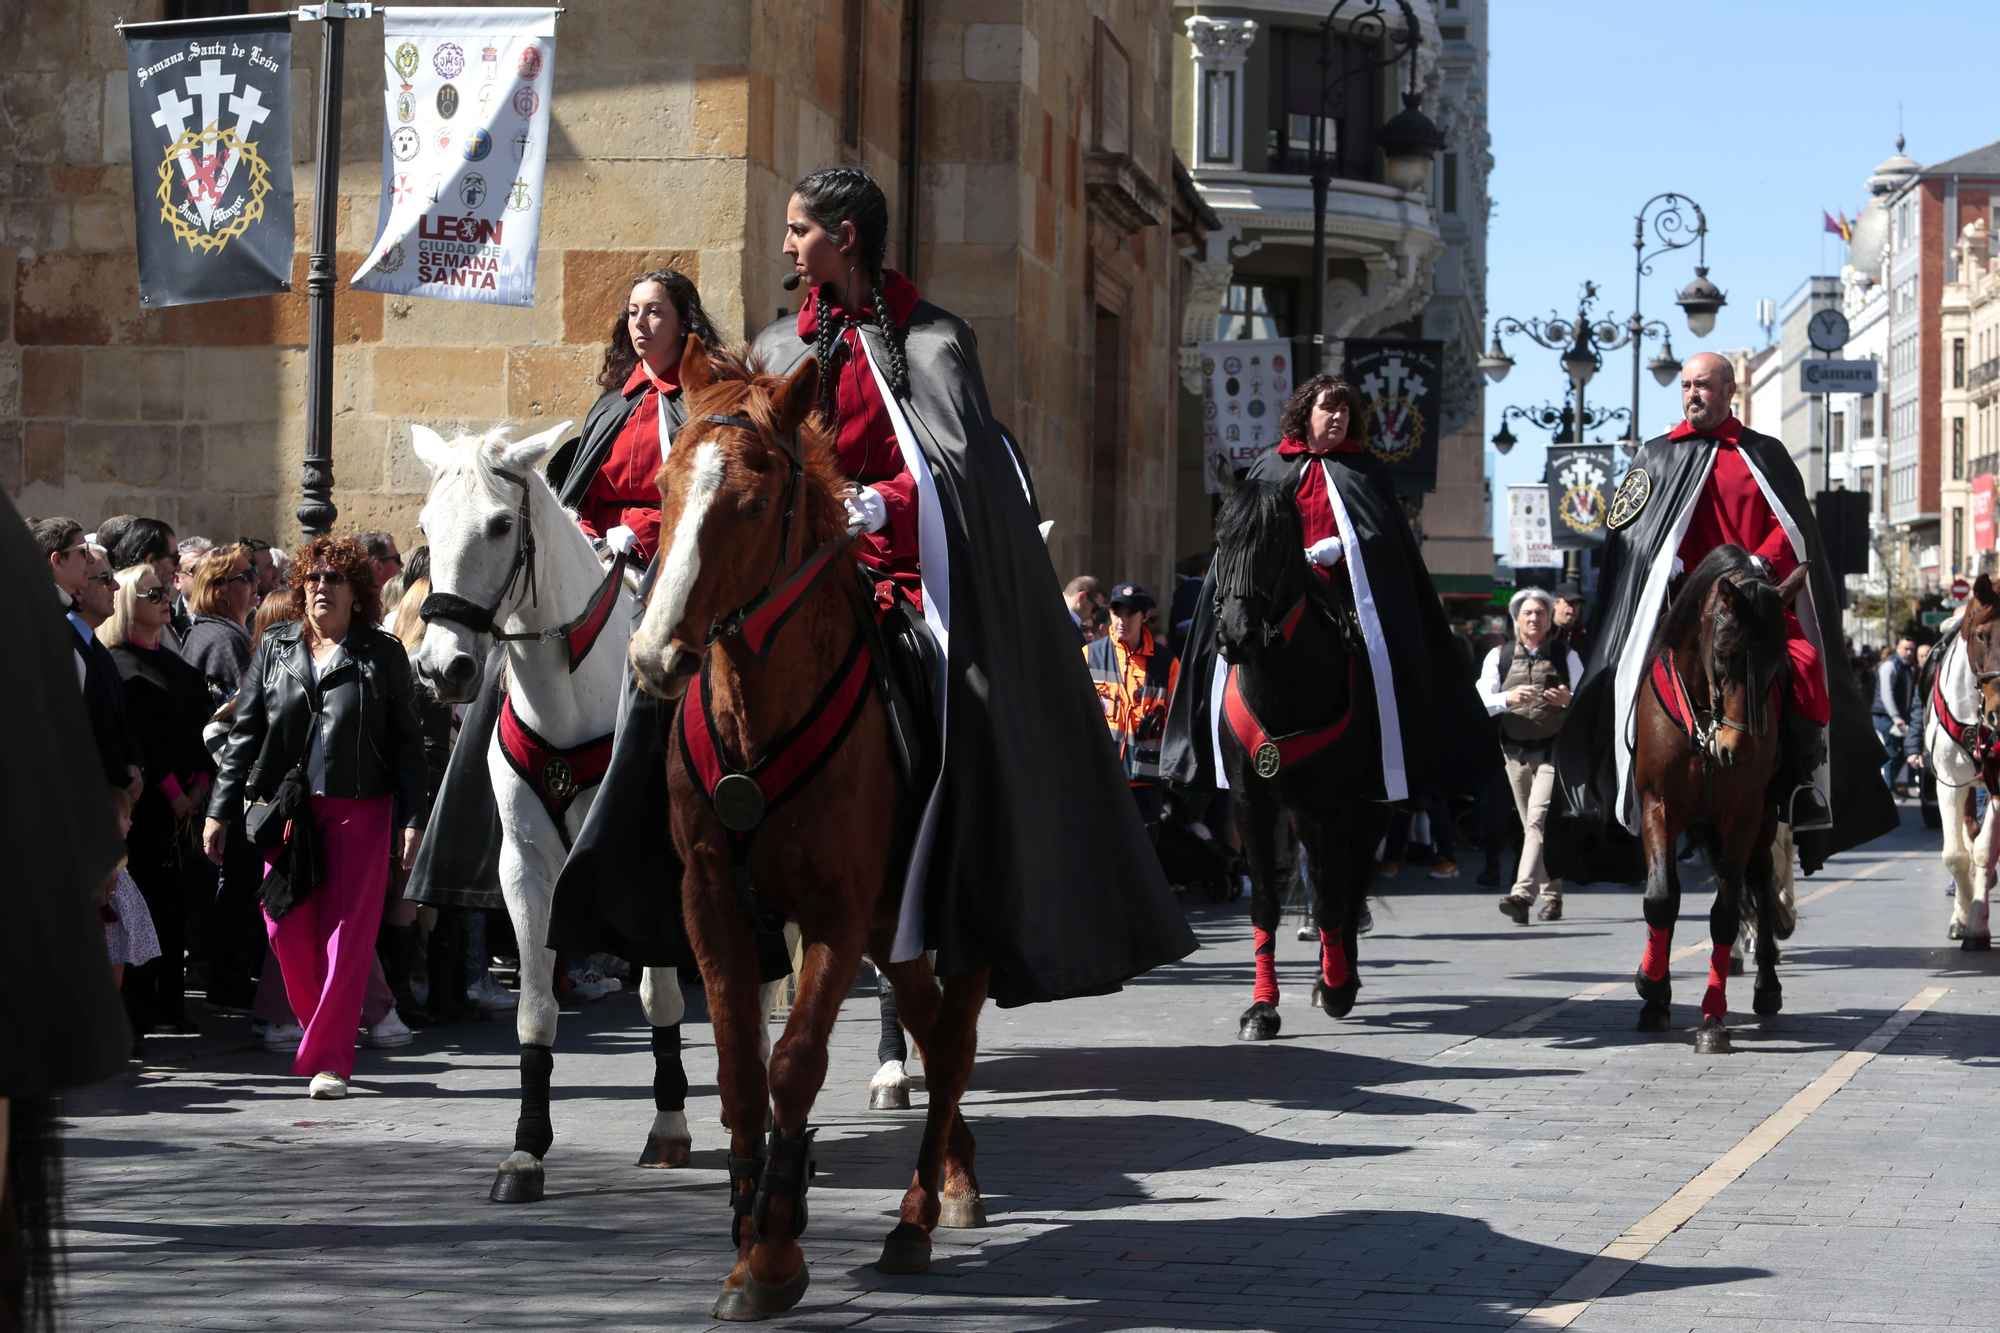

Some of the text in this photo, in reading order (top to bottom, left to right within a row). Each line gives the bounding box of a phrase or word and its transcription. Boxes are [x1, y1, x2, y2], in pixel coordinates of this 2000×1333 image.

[137, 41, 279, 88] Semana Santa de León
[178, 195, 245, 229] Junta Mayor
[418, 211, 503, 245] LEÓN
[418, 240, 501, 258] CIUDAD DE
[418, 251, 499, 272] SEMANA
[417, 265, 497, 290] SANTA
[1806, 363, 1873, 384] Cámara
